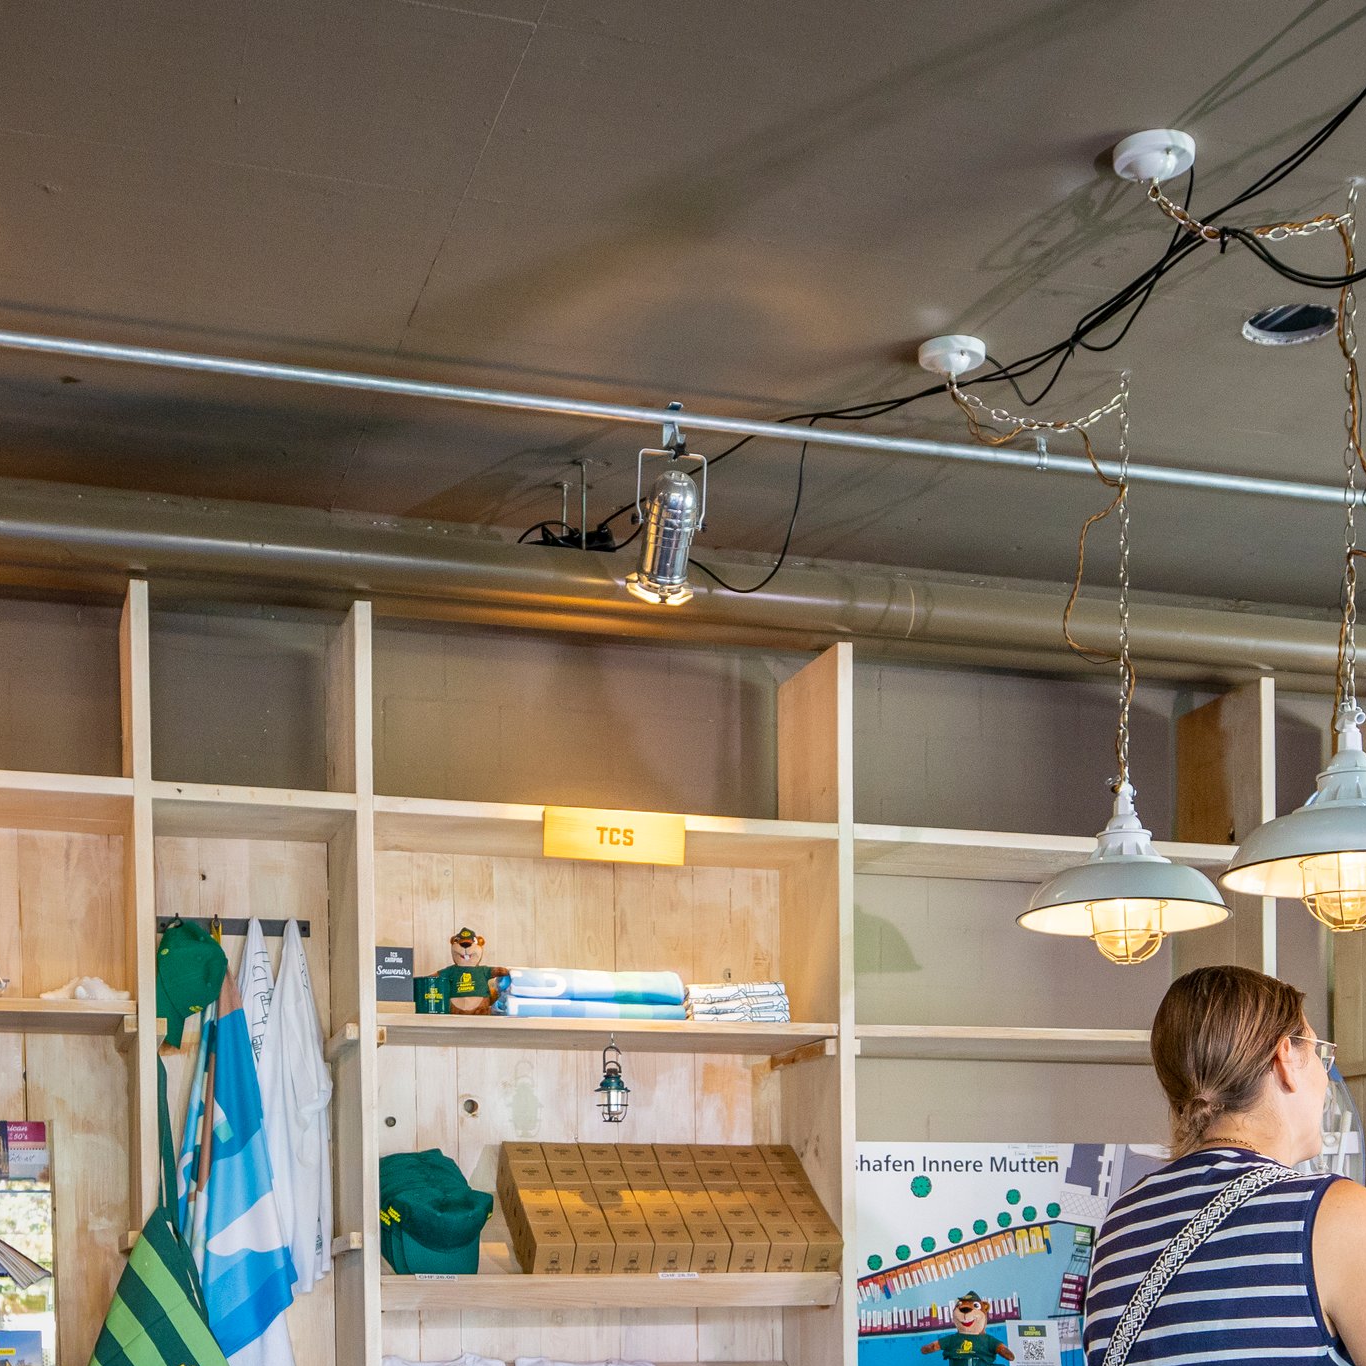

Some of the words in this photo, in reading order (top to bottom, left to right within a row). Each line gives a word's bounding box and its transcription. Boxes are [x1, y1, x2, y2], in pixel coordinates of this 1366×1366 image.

[596, 826, 634, 847] TCS
[377, 965, 411, 977] Souvenirs
[922, 1155, 983, 1173] Innere
[989, 1156, 1059, 1173] Mutten
